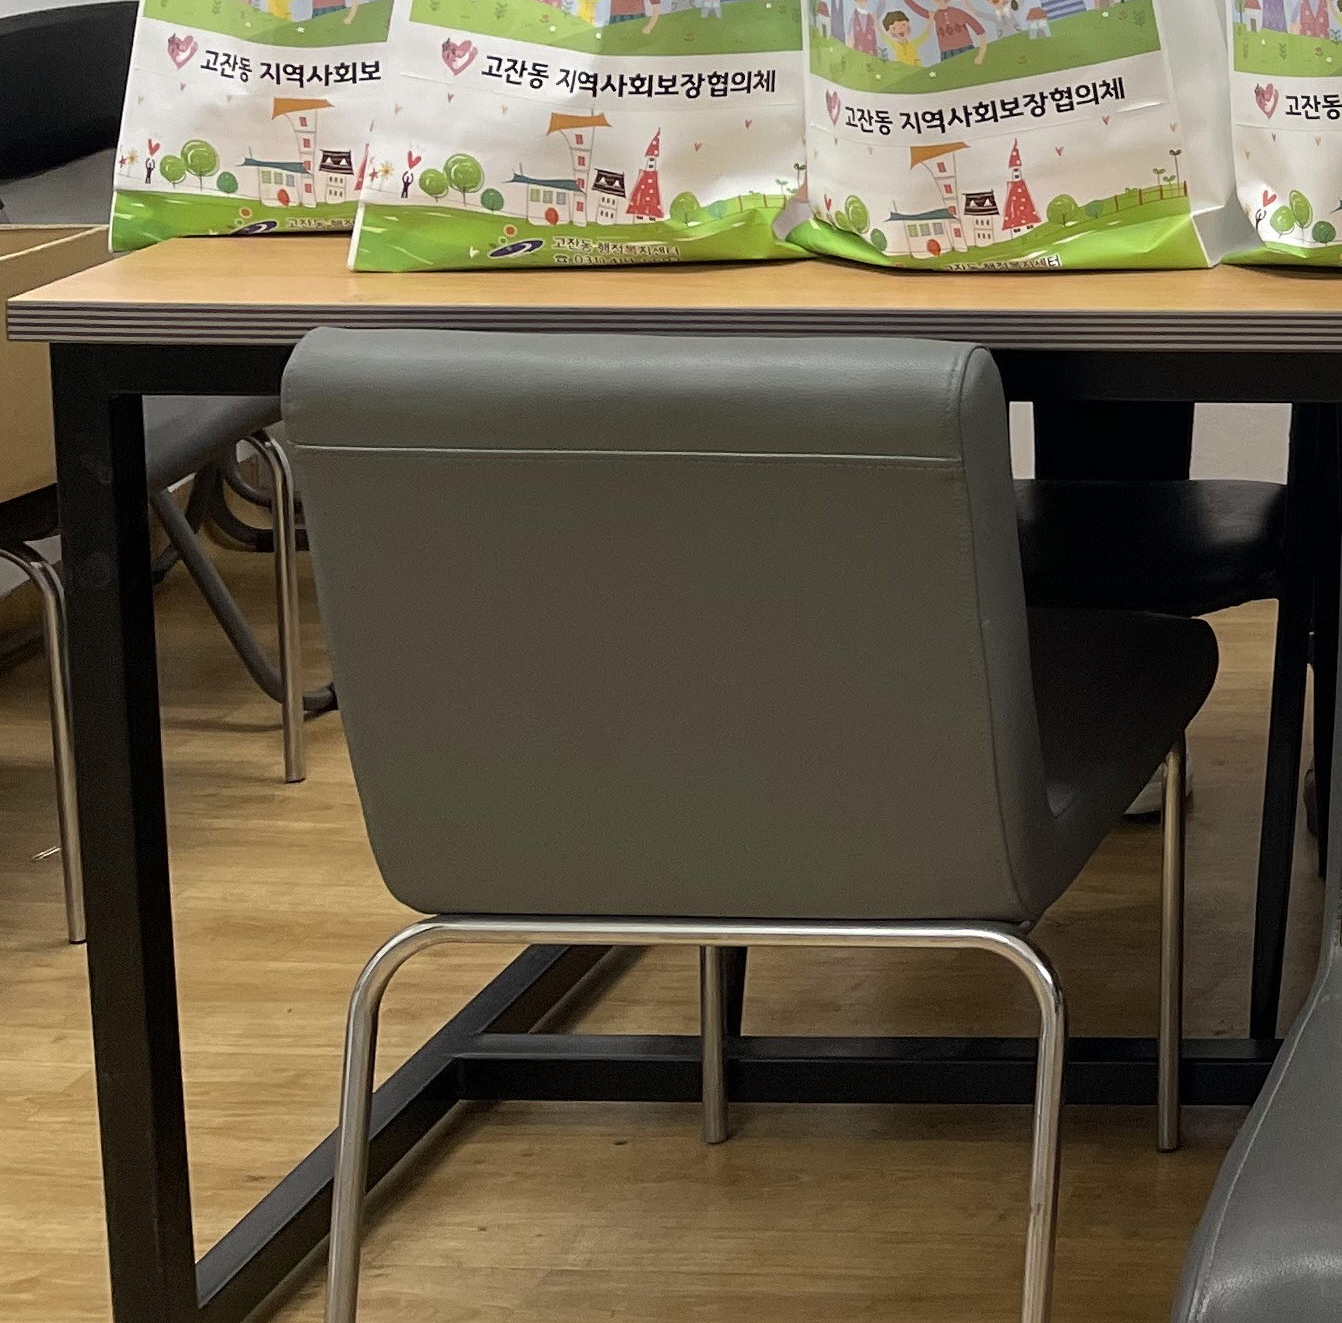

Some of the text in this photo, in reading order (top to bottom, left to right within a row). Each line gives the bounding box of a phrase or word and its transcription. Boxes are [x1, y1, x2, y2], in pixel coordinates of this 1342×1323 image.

[200, 49, 253, 83] 고잔동
[481, 55, 776, 99] 고잔동 지역사회보장협의체
[845, 77, 1126, 136] 고잔동 지역사회보장협의체
[1285, 94, 1342, 120] 고잔동
